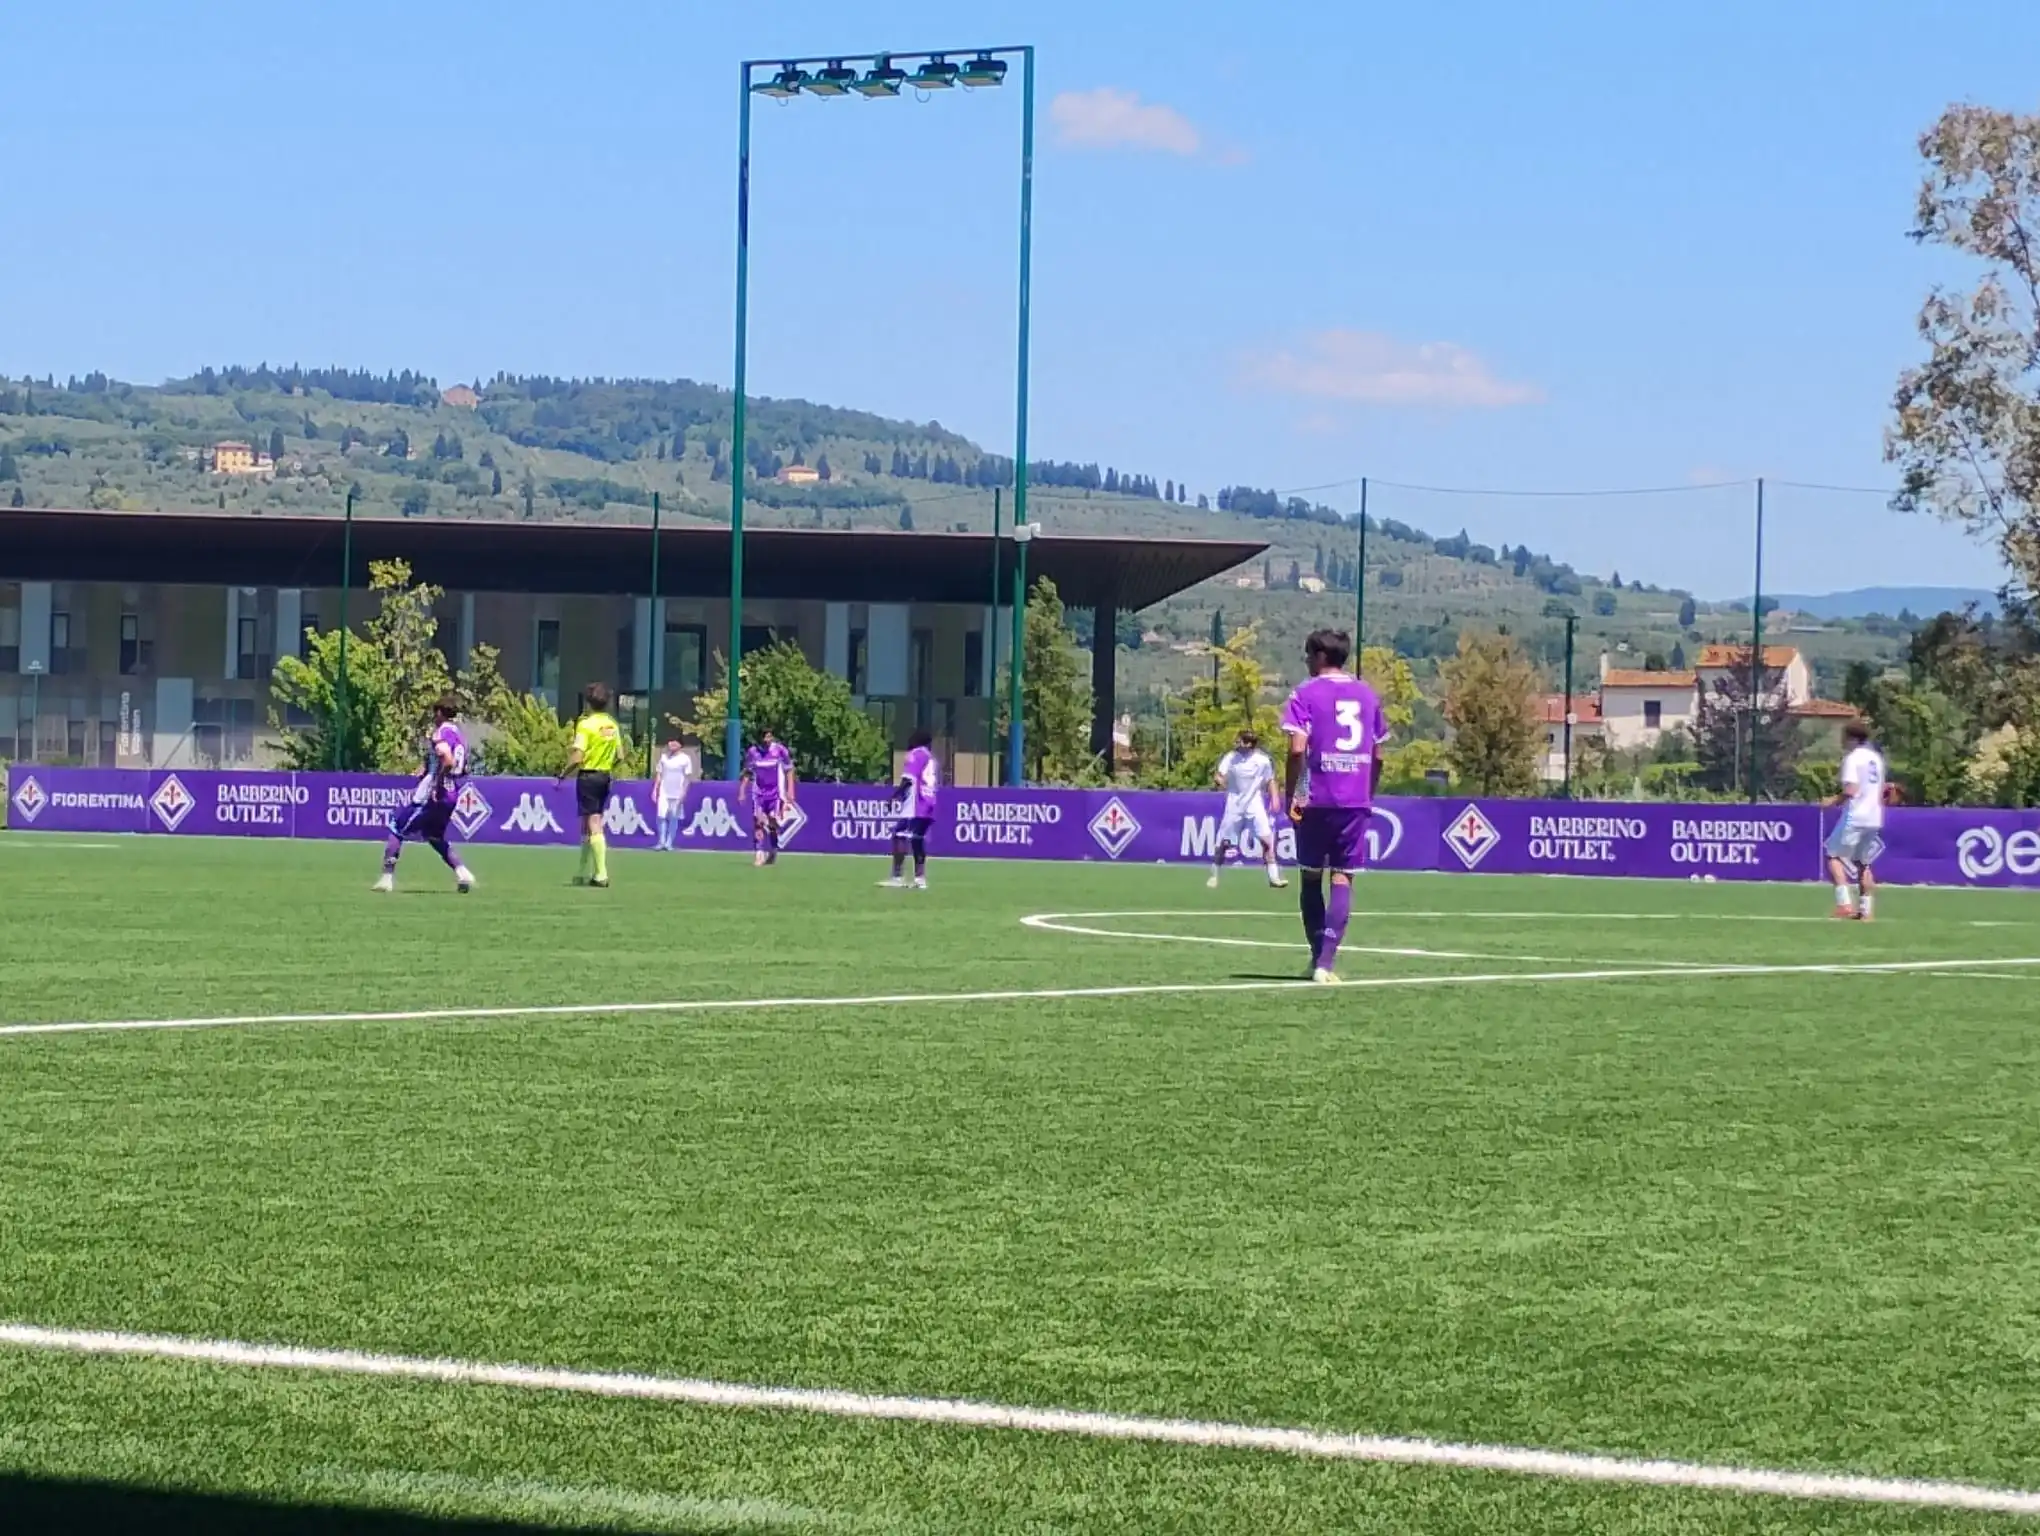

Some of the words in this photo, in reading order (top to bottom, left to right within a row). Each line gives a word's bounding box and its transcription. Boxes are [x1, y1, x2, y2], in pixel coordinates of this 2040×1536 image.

[1335, 700, 1361, 751] 3
[51, 792, 144, 808] FIORENTINA
[217, 784, 309, 804] BARBERINO
[328, 786, 412, 807] BARBERIN
[327, 807, 393, 826] OUTLET
[832, 799, 901, 818] BARBER
[956, 802, 1061, 824] BARBERINO
[832, 820, 897, 840] OUTLE
[1529, 816, 1646, 839] BARBERINO
[1672, 820, 1791, 842] BARBERINO
